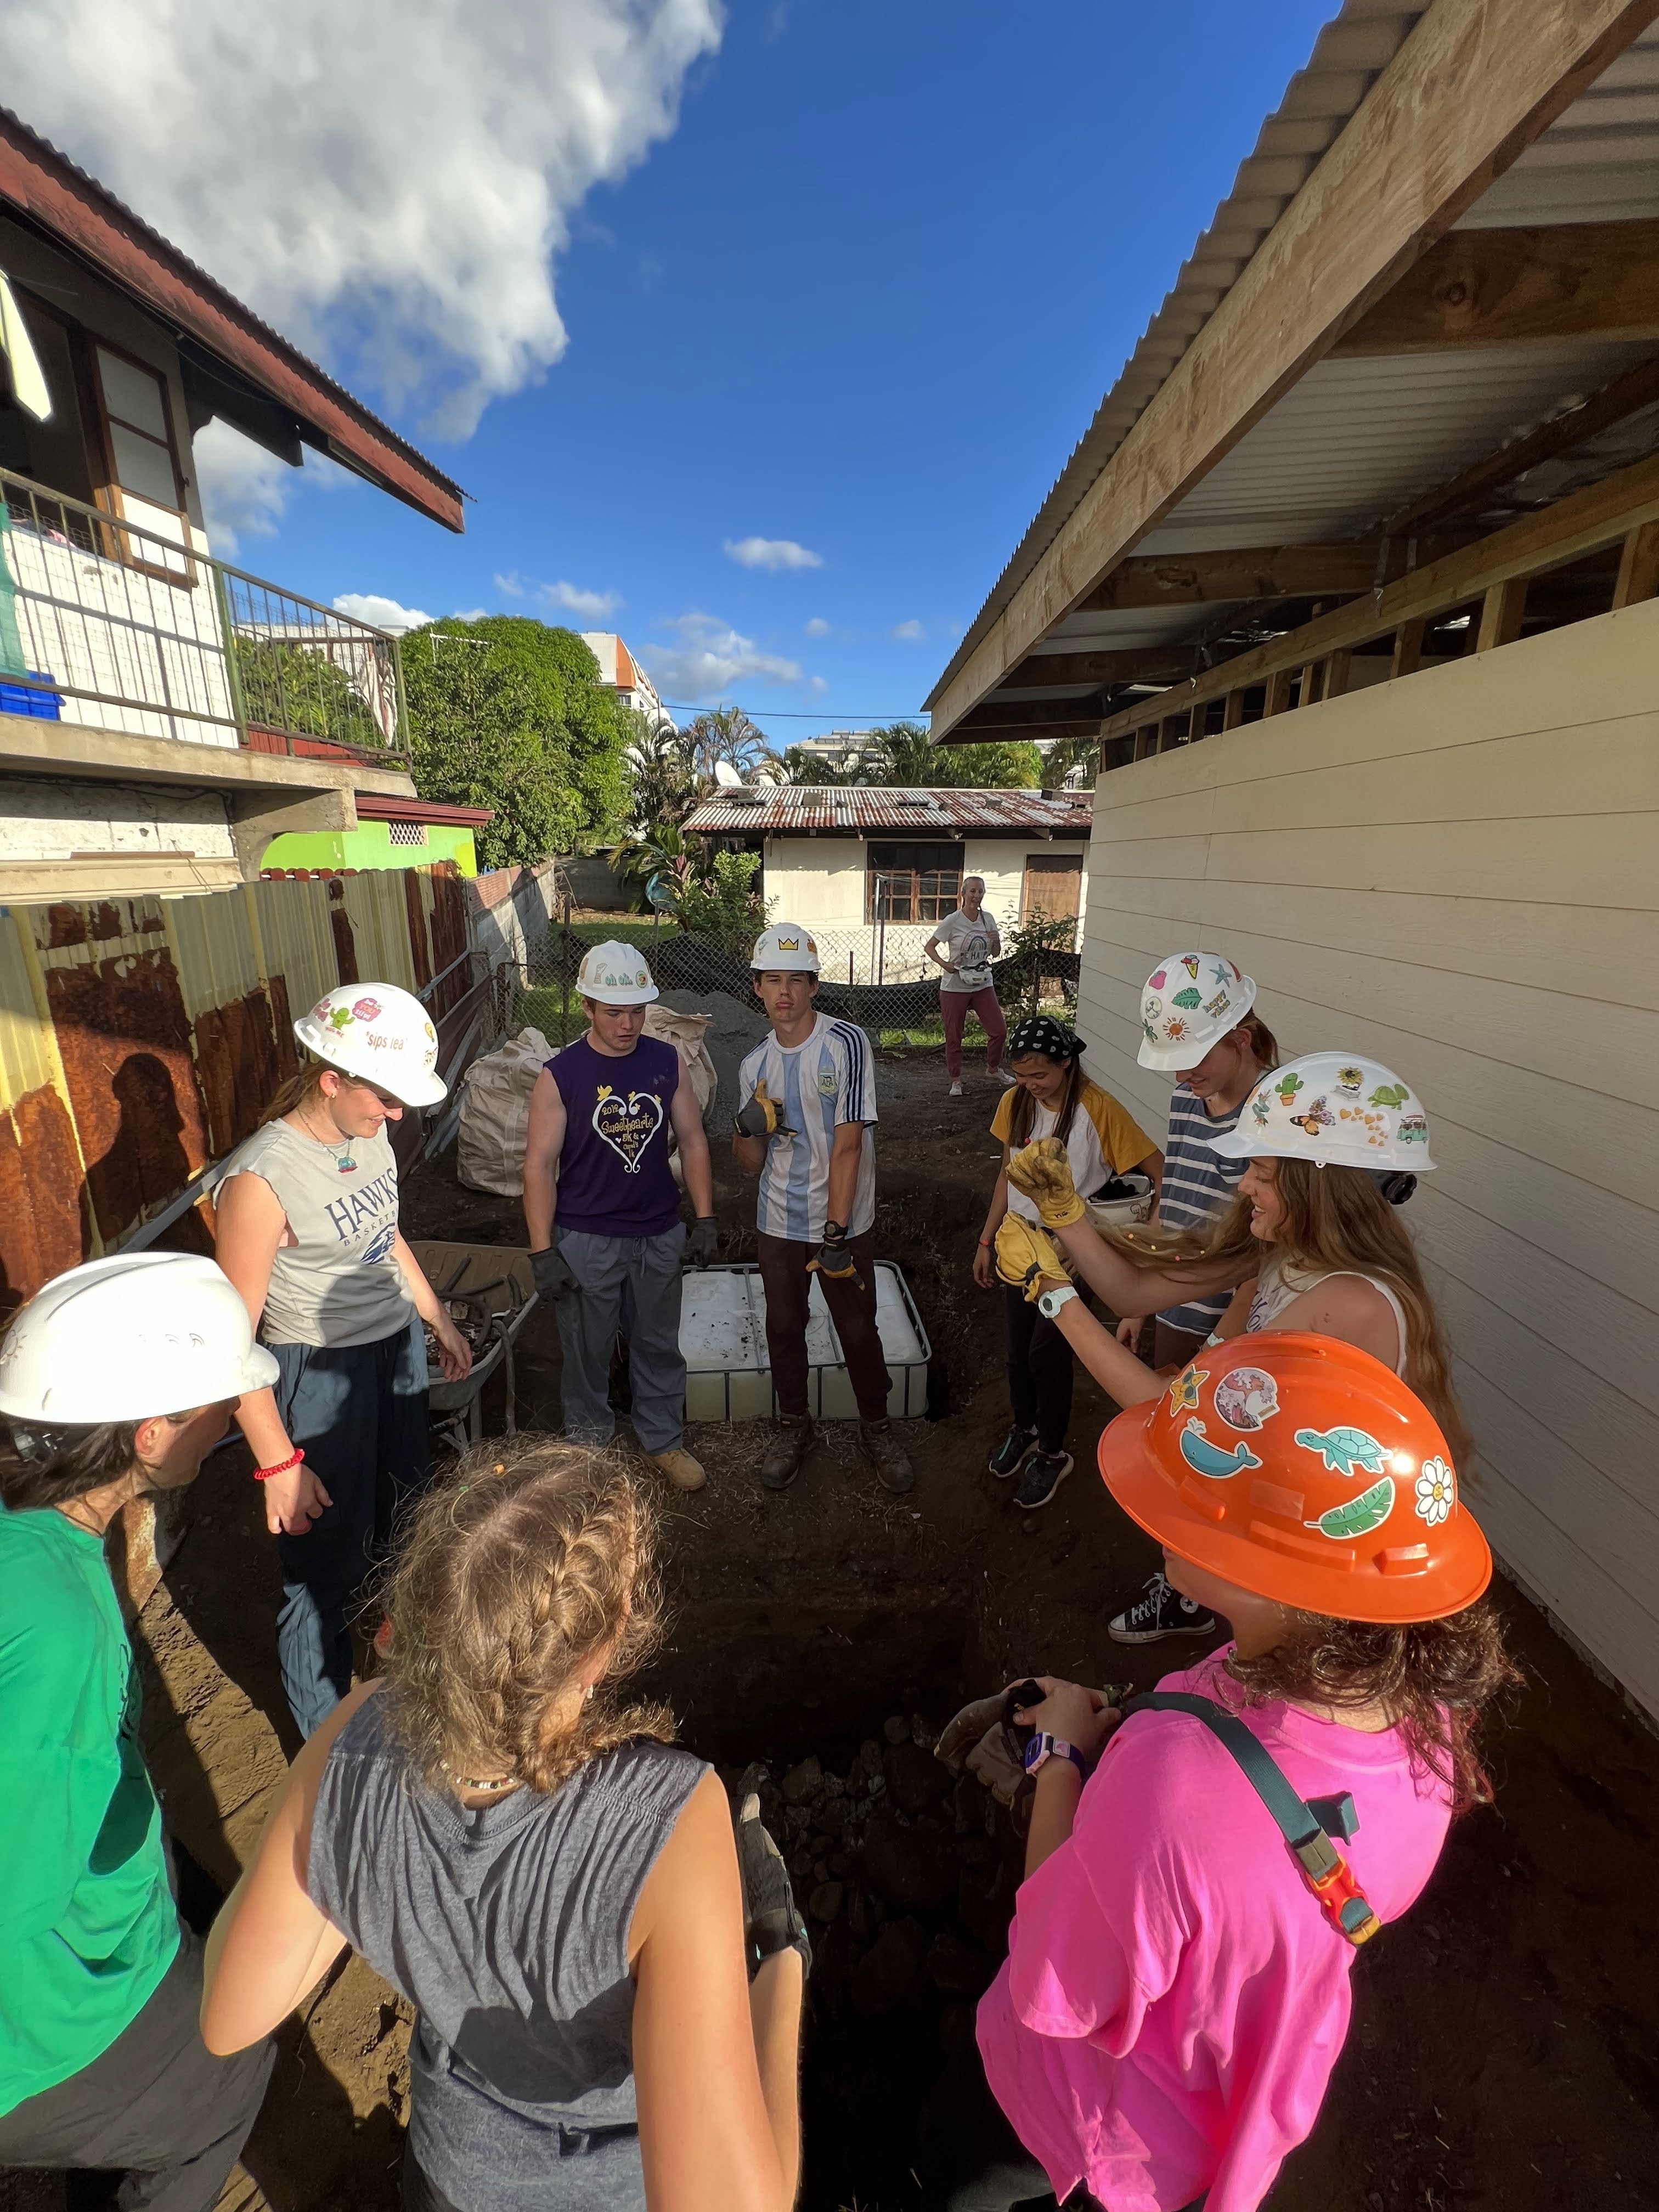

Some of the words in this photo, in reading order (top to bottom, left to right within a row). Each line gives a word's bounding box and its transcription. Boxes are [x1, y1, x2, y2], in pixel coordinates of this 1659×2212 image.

[359, 1003, 376, 1014] YOU
[821, 1075, 833, 1088] AFA
[602, 1104, 619, 1115] 2012
[601, 1113, 653, 1134] Sweethearts
